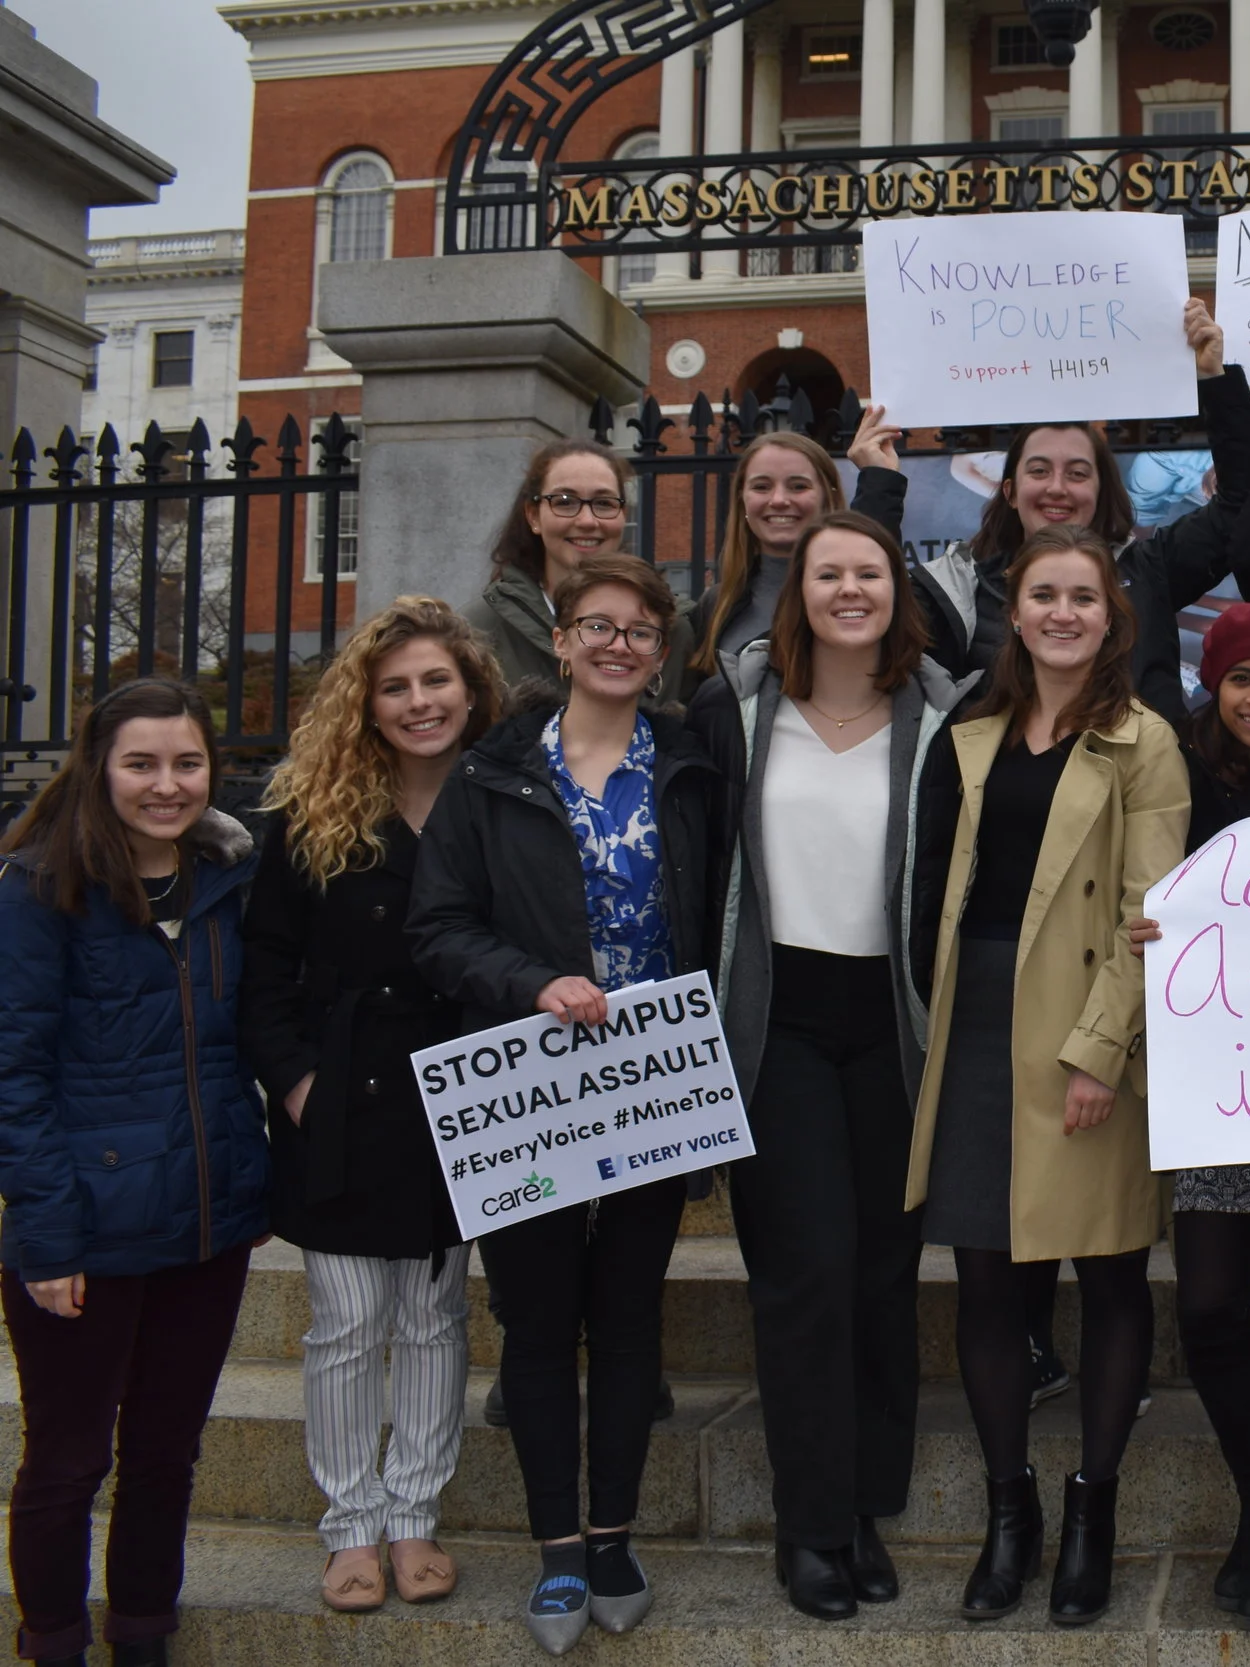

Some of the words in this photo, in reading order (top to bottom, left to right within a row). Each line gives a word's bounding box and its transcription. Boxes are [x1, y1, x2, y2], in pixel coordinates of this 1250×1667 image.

[564, 164, 1101, 225] MASSACHUSETTS
[972, 299, 1141, 342] POWER
[1050, 357, 1110, 380] H4159
[422, 1038, 527, 1095] STOP
[539, 988, 711, 1057] CAMPUS
[437, 1081, 571, 1142] SEXUAL
[578, 1037, 721, 1100] ASSAULT
[451, 1120, 606, 1181] #EveryVoice
[614, 1086, 734, 1130] #MineToo
[627, 1142, 682, 1170] EVERY
[686, 1127, 739, 1154] VOICE
[481, 1176, 558, 1216] care2
